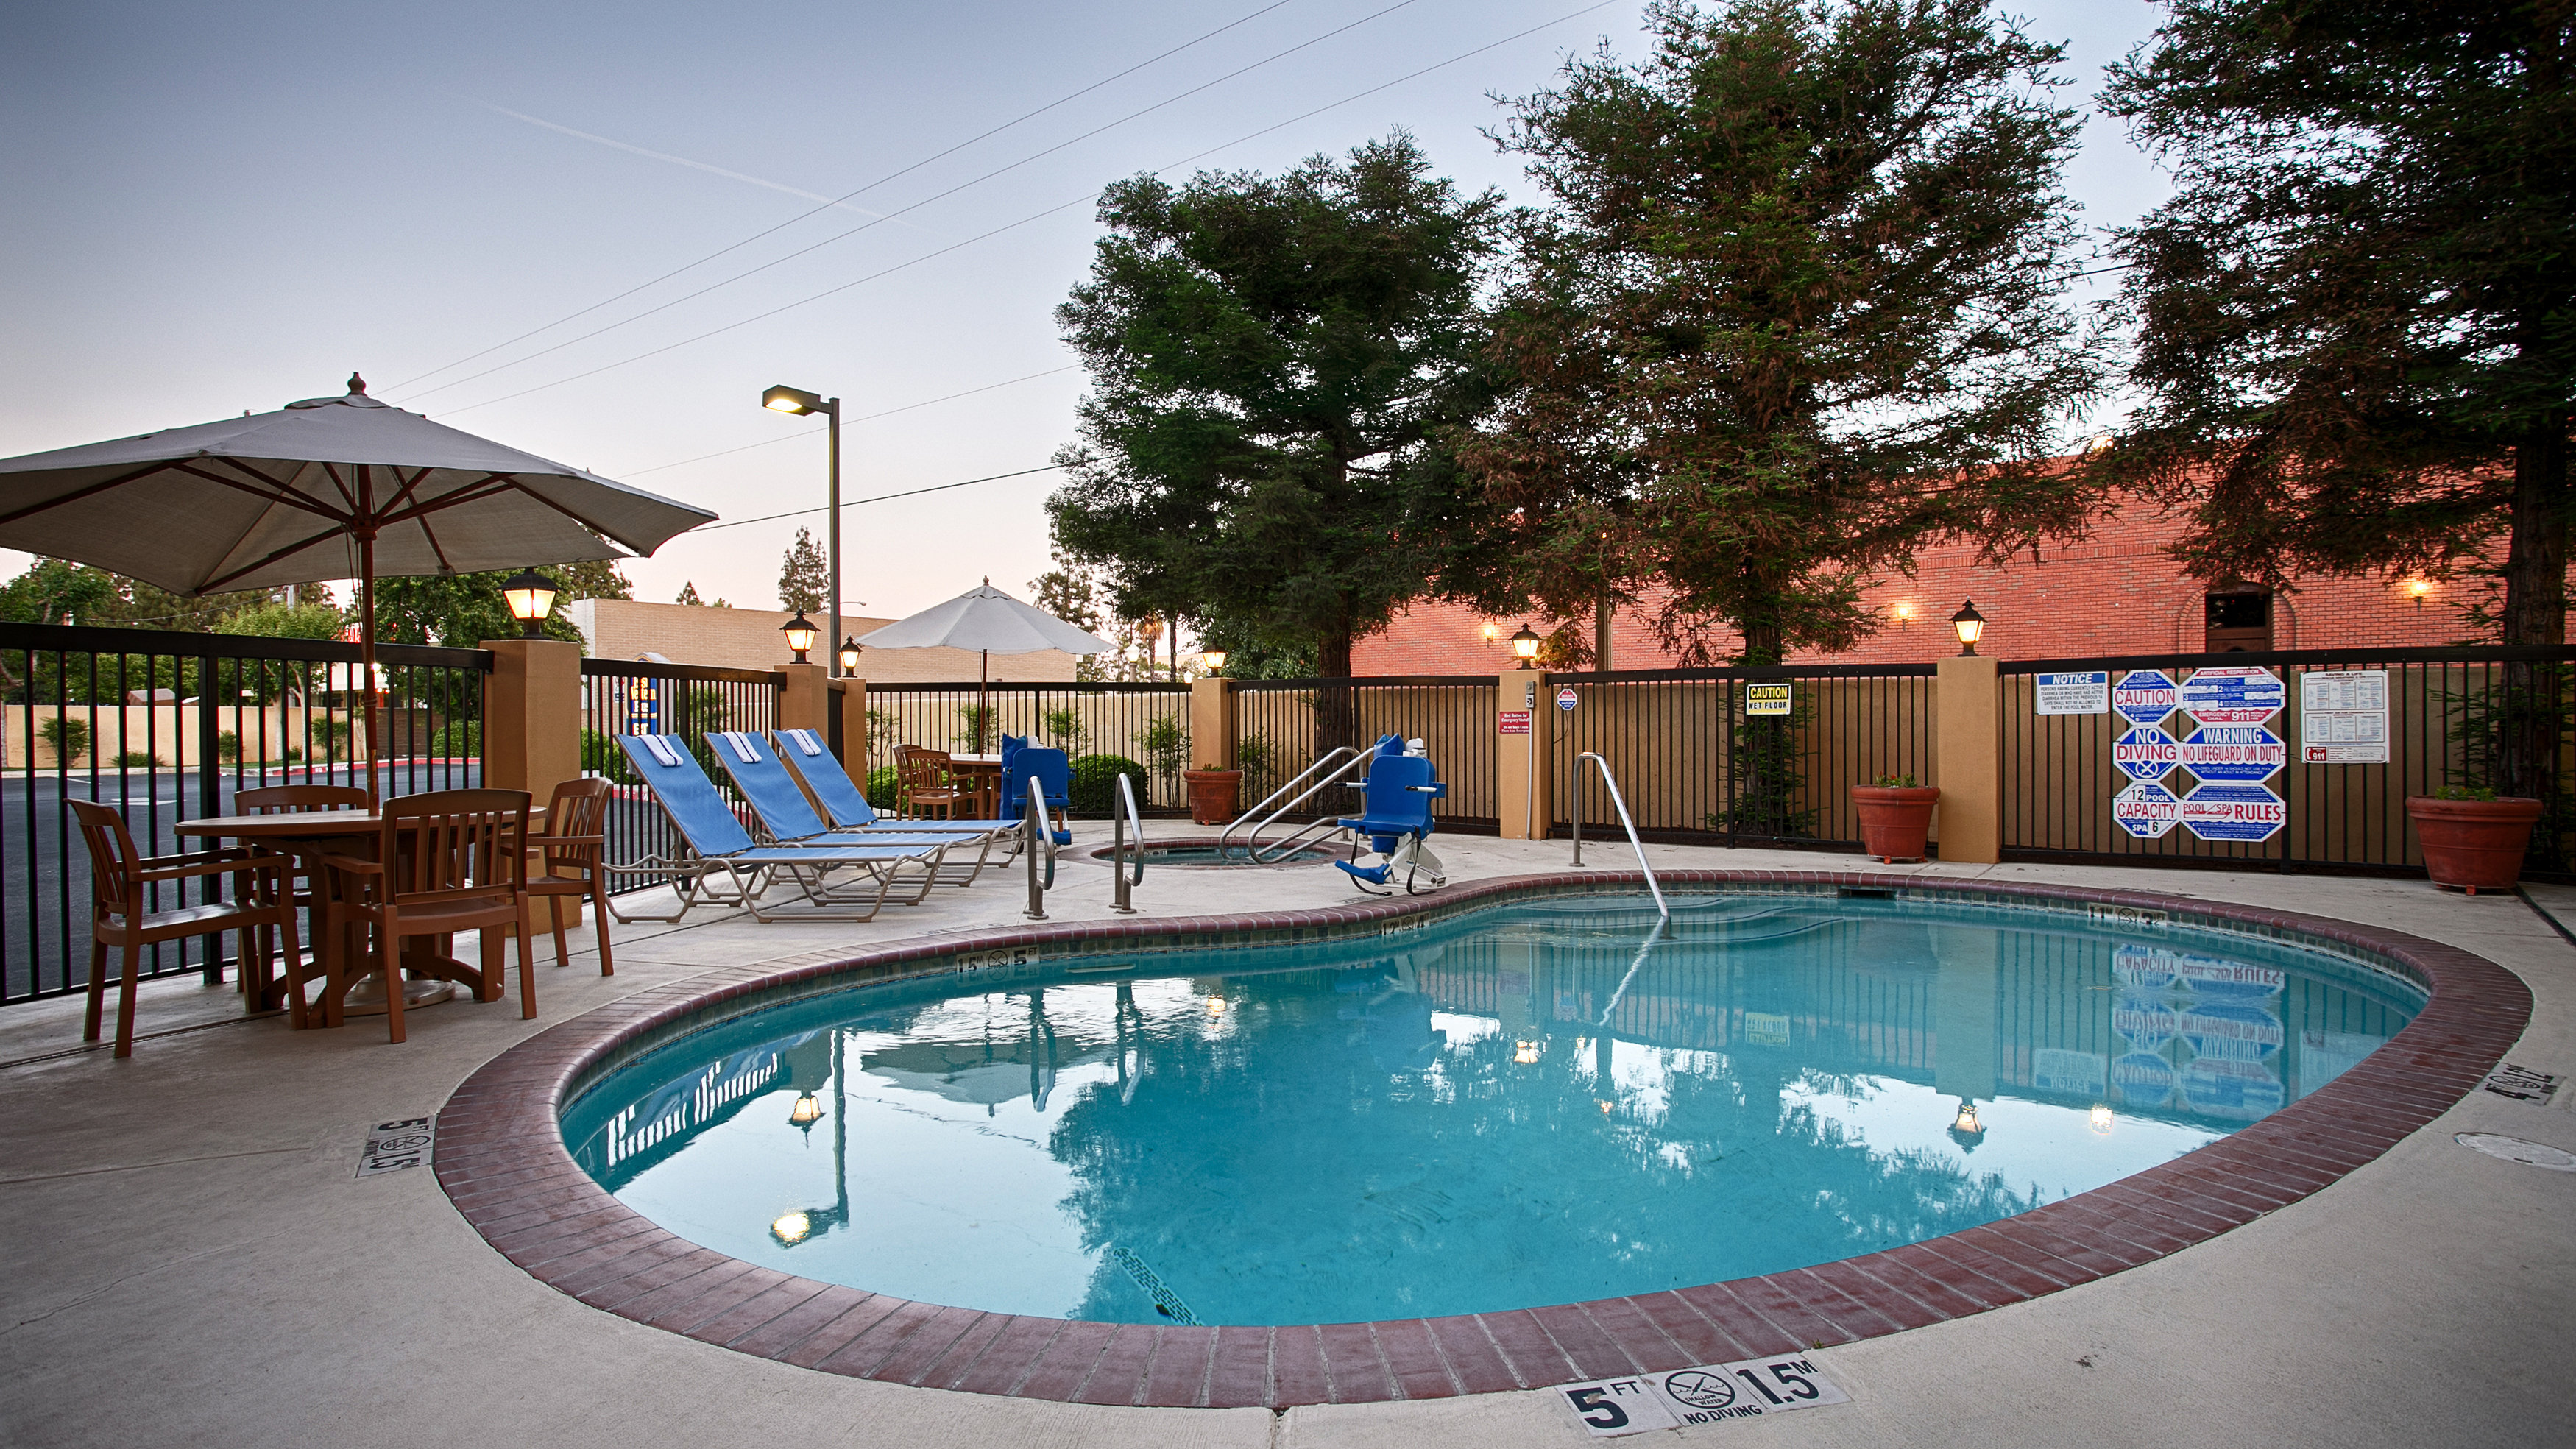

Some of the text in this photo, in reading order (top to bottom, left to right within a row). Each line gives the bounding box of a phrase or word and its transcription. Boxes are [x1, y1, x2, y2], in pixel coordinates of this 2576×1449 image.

[2052, 674, 2093, 684] NOTICE
[1750, 687, 1787, 698] CAUTION
[2115, 689, 2176, 704] CAUTION
[2232, 711, 2250, 721] 911
[2136, 729, 2160, 744] NO
[2203, 728, 2262, 743] WARNING
[2117, 745, 2176, 760] DIVING
[2183, 746, 2282, 761] NO LIFEGUARD ON DUTY
[2313, 752, 2324, 760] 911
[2131, 789, 2144, 801] 12
[2117, 803, 2176, 818] CAPACITY
[2217, 804, 2232, 812] SPA
[2234, 805, 2282, 821] RULES
[2152, 821, 2158, 832] 6
[1014, 947, 1038, 965] 5 FT
[2485, 1087, 2541, 1100] 4
[378, 1117, 428, 1130] 5
[1737, 1360, 1819, 1405] 1.5 M
[1566, 1381, 1641, 1429] 5 FT
[1685, 1394, 1716, 1402] SHALLOW
[1683, 1404, 1762, 1425] NO DIVING
